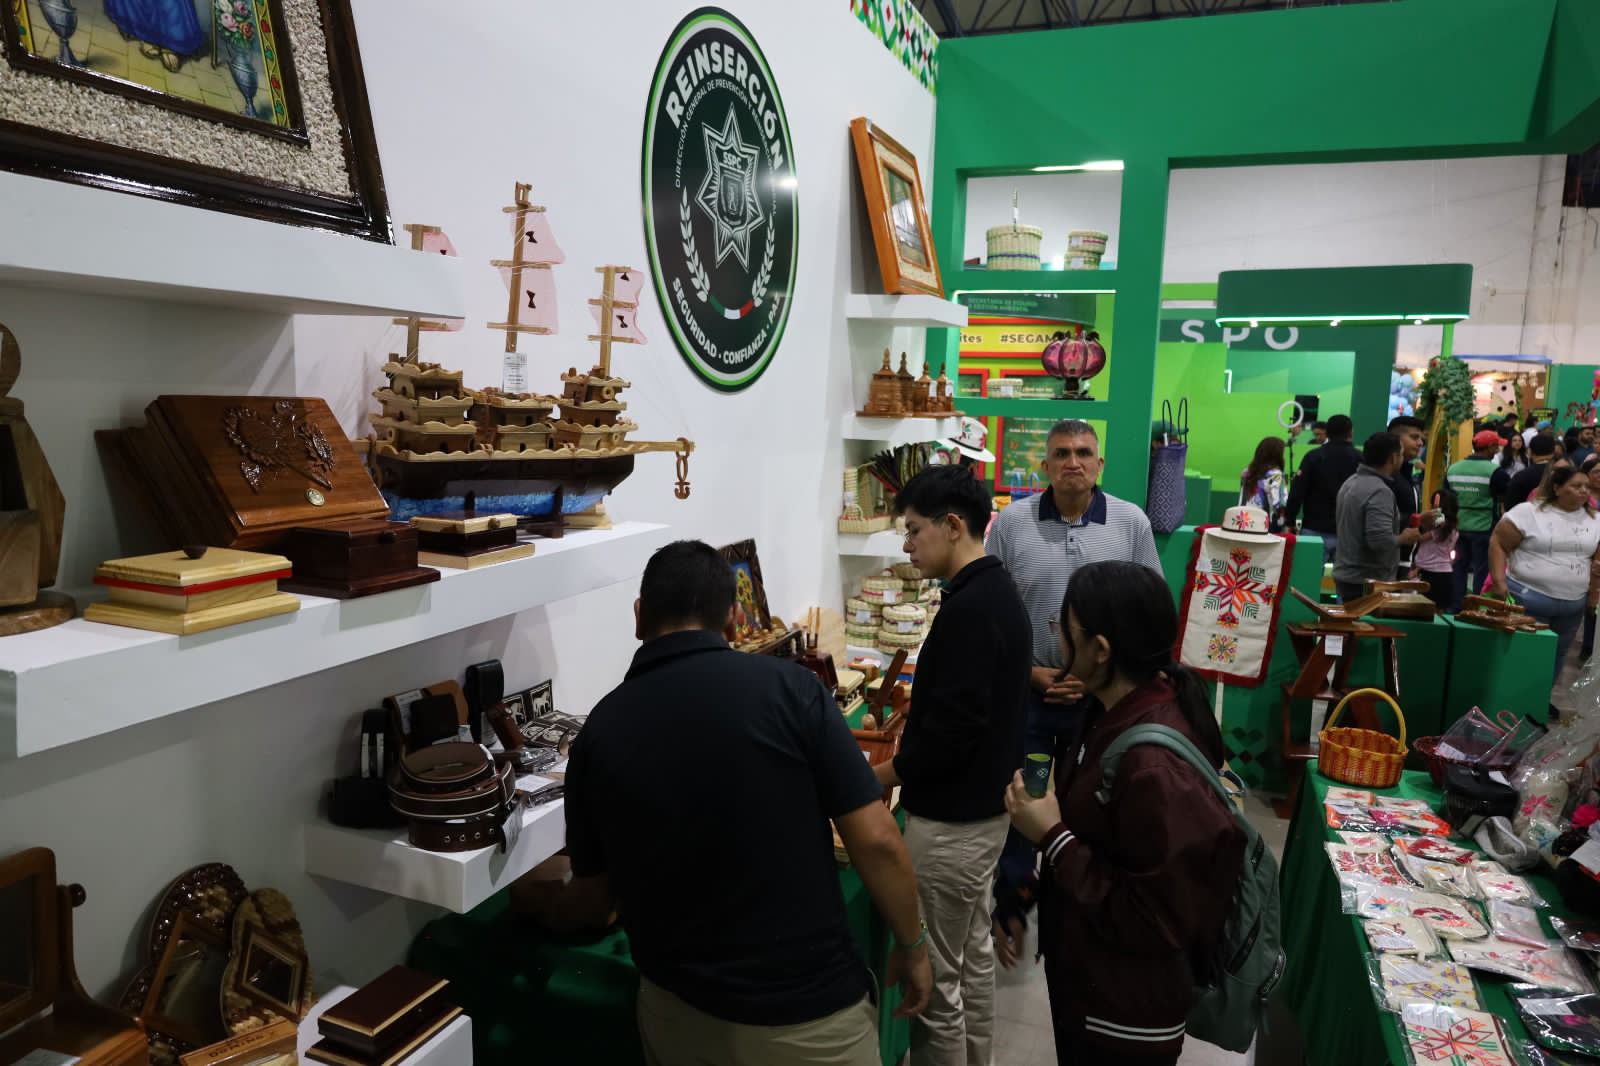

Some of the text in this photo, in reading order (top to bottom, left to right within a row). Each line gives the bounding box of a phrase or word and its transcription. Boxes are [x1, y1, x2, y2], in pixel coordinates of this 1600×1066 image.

[665, 41, 783, 170] REINSERCIÓN
[686, 86, 707, 121] GENERAL
[706, 79, 716, 91] DE
[722, 151, 742, 169] SSPC
[672, 277, 717, 358] SEGURIDAD
[723, 329, 768, 364] CONFIANZA
